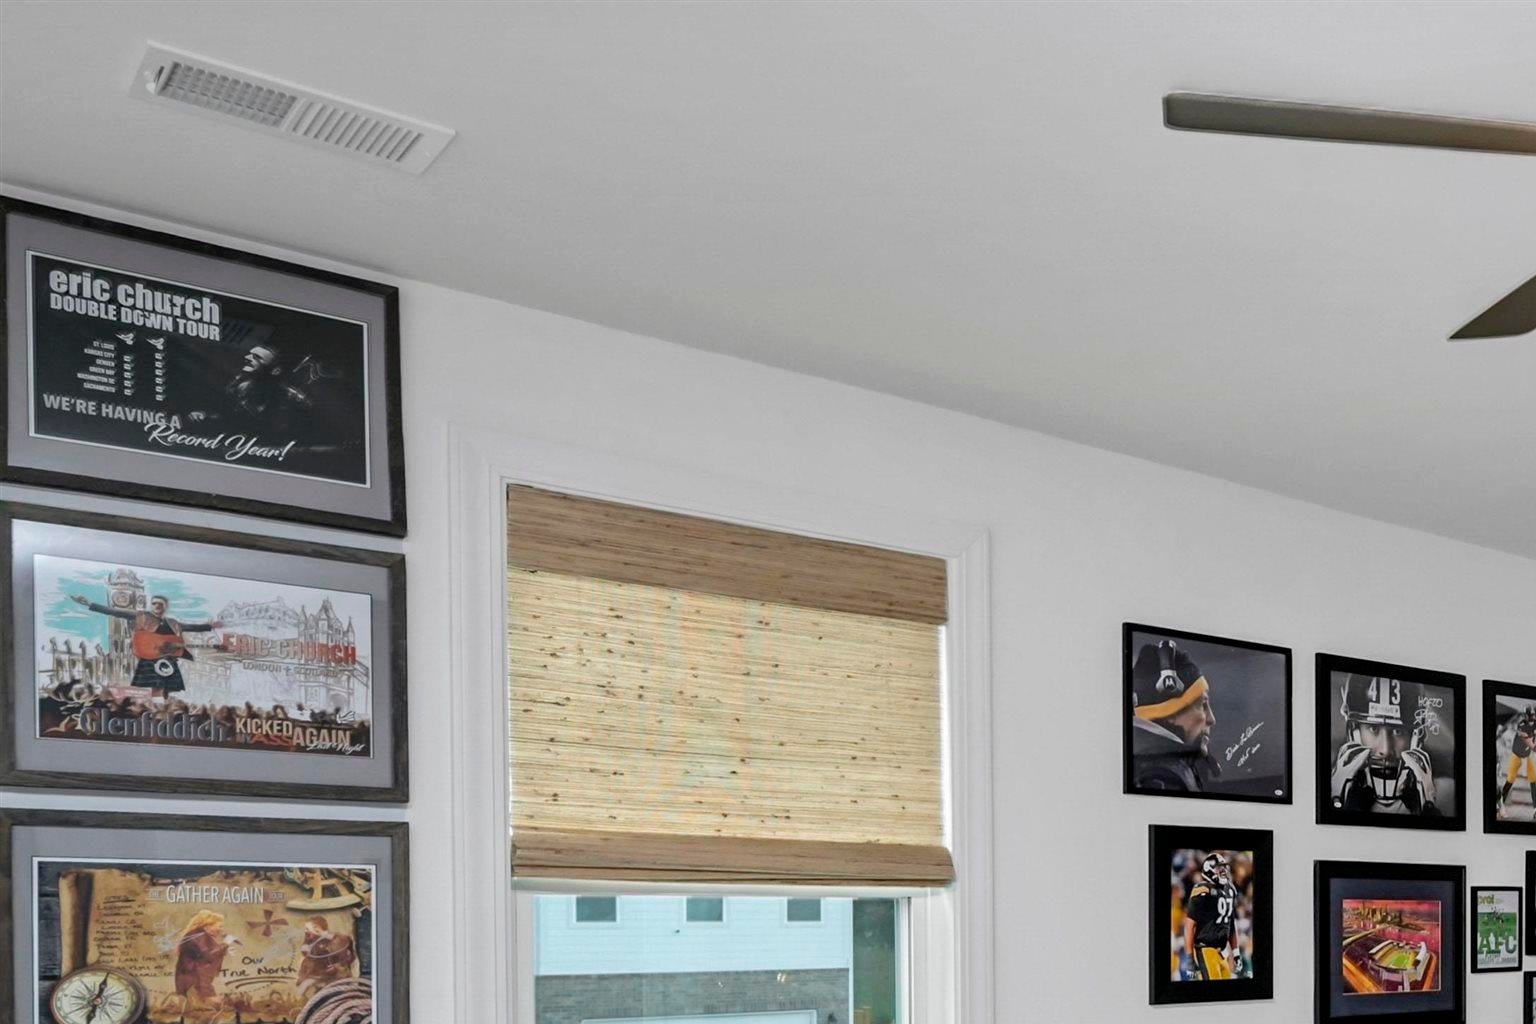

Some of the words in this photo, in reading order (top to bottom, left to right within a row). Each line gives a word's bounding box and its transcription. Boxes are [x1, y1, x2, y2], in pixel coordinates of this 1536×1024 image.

[49, 270, 111, 302] eric
[117, 283, 221, 325] church
[50, 292, 118, 321] DOUBLE
[121, 307, 173, 332] DOWN
[176, 318, 221, 342] TOUR
[43, 393, 97, 416] WE'RE
[101, 403, 165, 426] HAVING
[170, 416, 182, 429] A
[144, 422, 225, 449] Record
[225, 434, 296, 461] Year!
[277, 640, 357, 666] CHURCH
[236, 718, 293, 736] KICKED
[293, 727, 351, 747] AGAIN
[166, 884, 220, 903] GATHER
[222, 887, 264, 904] AGAIN
[1216, 896, 1233, 924] 97
[258, 967, 298, 975] North
